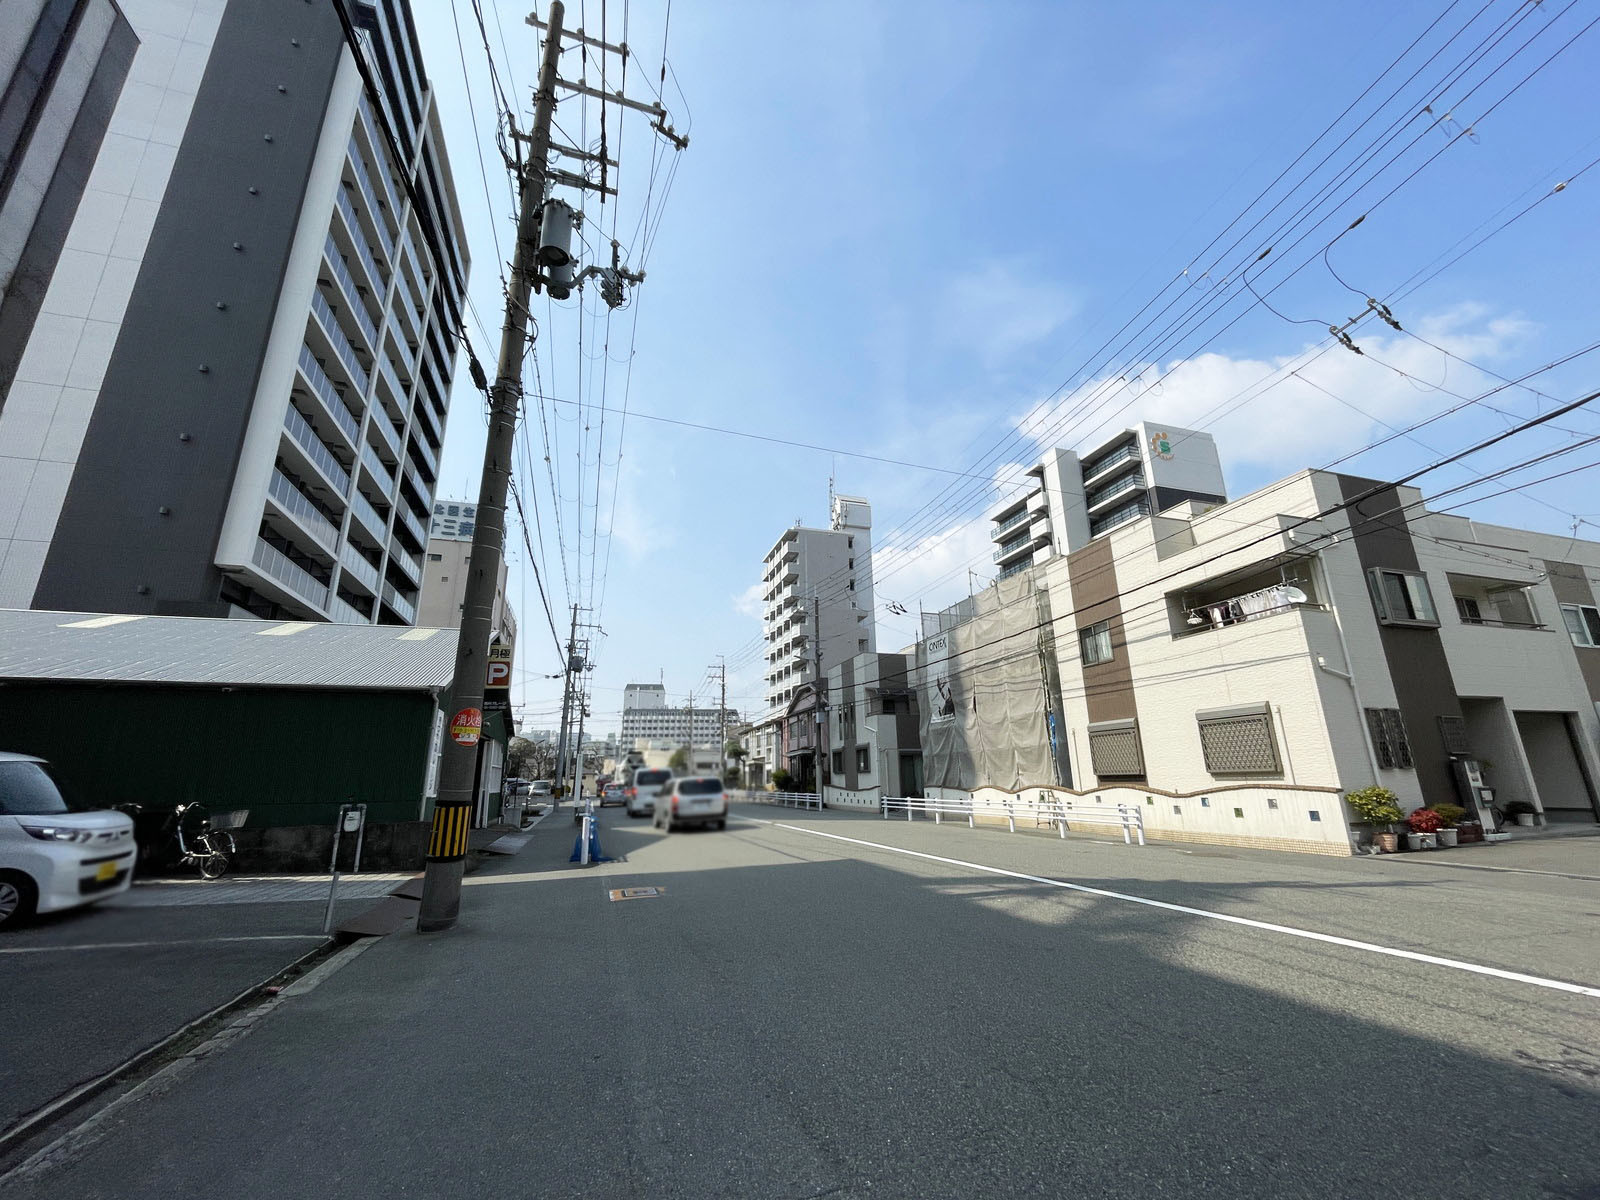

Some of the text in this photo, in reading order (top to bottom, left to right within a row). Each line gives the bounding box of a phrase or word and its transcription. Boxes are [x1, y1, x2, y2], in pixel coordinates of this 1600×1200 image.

[431, 518, 475, 536] 十三病
[490, 648, 511, 659] 月極
[487, 663, 509, 684] P
